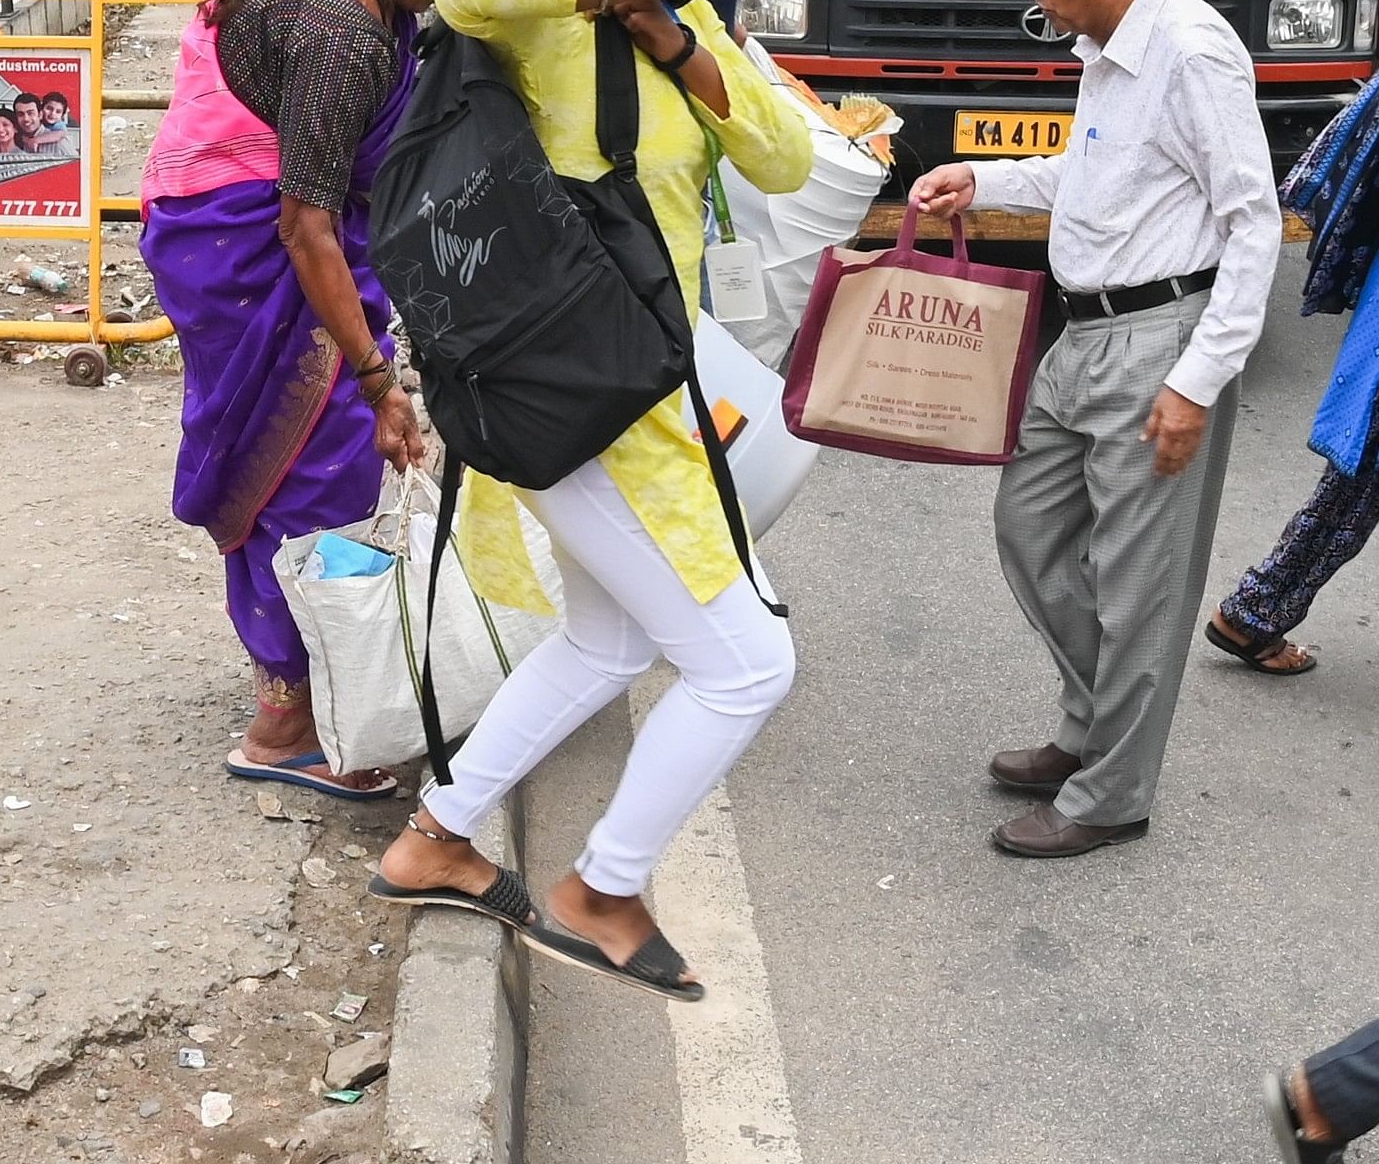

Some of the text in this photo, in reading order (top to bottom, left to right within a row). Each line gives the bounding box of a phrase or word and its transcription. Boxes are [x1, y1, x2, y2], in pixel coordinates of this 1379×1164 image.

[975, 120, 1003, 146] KA
[1011, 121, 1039, 147] 41
[1, 200, 36, 215] 777
[42, 201, 78, 216] 777
[873, 289, 983, 332] ARUNA
[865, 322, 983, 352] SILK PARADISE
